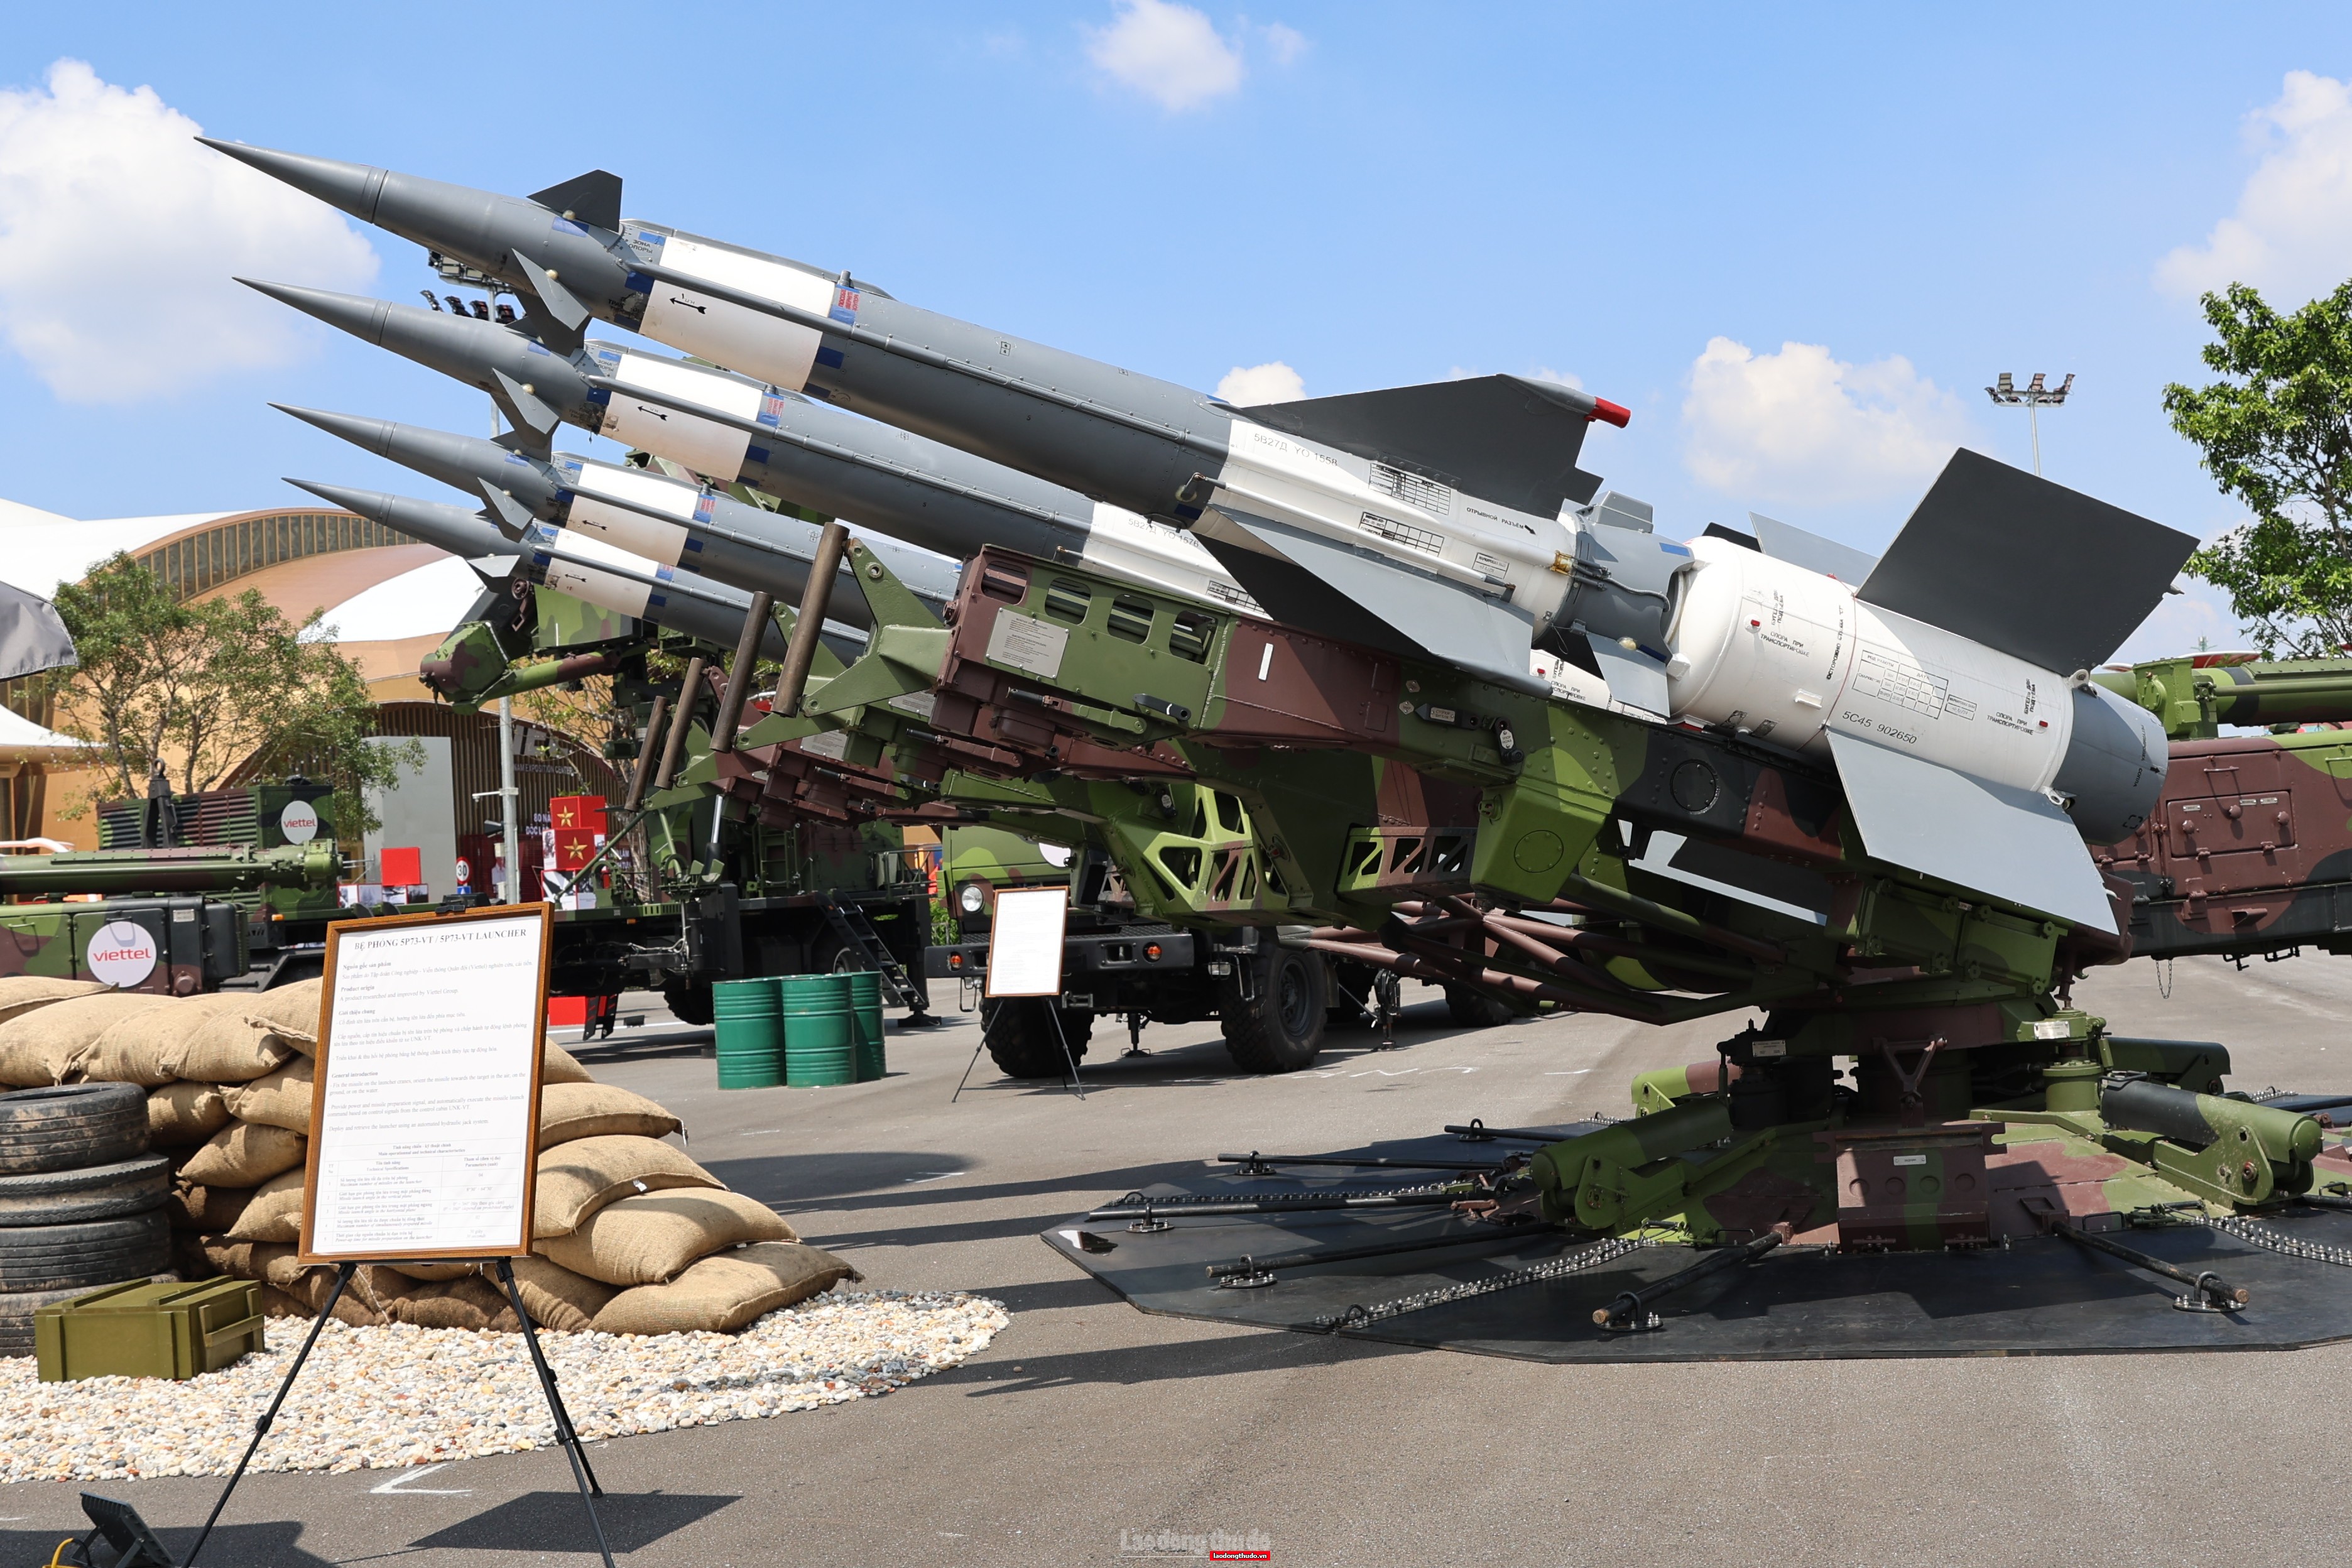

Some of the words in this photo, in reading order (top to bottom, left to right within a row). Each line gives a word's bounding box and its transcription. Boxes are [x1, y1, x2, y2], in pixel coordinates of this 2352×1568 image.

[1314, 452, 1337, 467] 1558
[1467, 507, 1498, 521] ОТРЫВНОЙ
[1178, 535, 1199, 548] 1576
[1760, 633, 1810, 657] ТРАНСПОРТИРОВКЕ
[1770, 631, 1788, 642] ОПОРА
[1792, 640, 1804, 648] ПРИ
[1826, 643, 1841, 680] ОСТОРОЖНО
[1996, 712, 2013, 721] ОПОРА
[1986, 715, 2034, 736] ТРАНСПОРТИРОВКЕ
[1876, 724, 1917, 744] 902650
[555, 766, 573, 774] CENTER
[2133, 768, 2143, 787] СОПЛА
[283, 819, 316, 828] viettel
[533, 813, 542, 822] 80
[458, 865, 467, 876] 30
[401, 936, 433, 945] 5P73-VT
[440, 933, 473, 942] 5P73-VT
[476, 929, 526, 939] LAUNCHER
[93, 948, 151, 962] viettel
